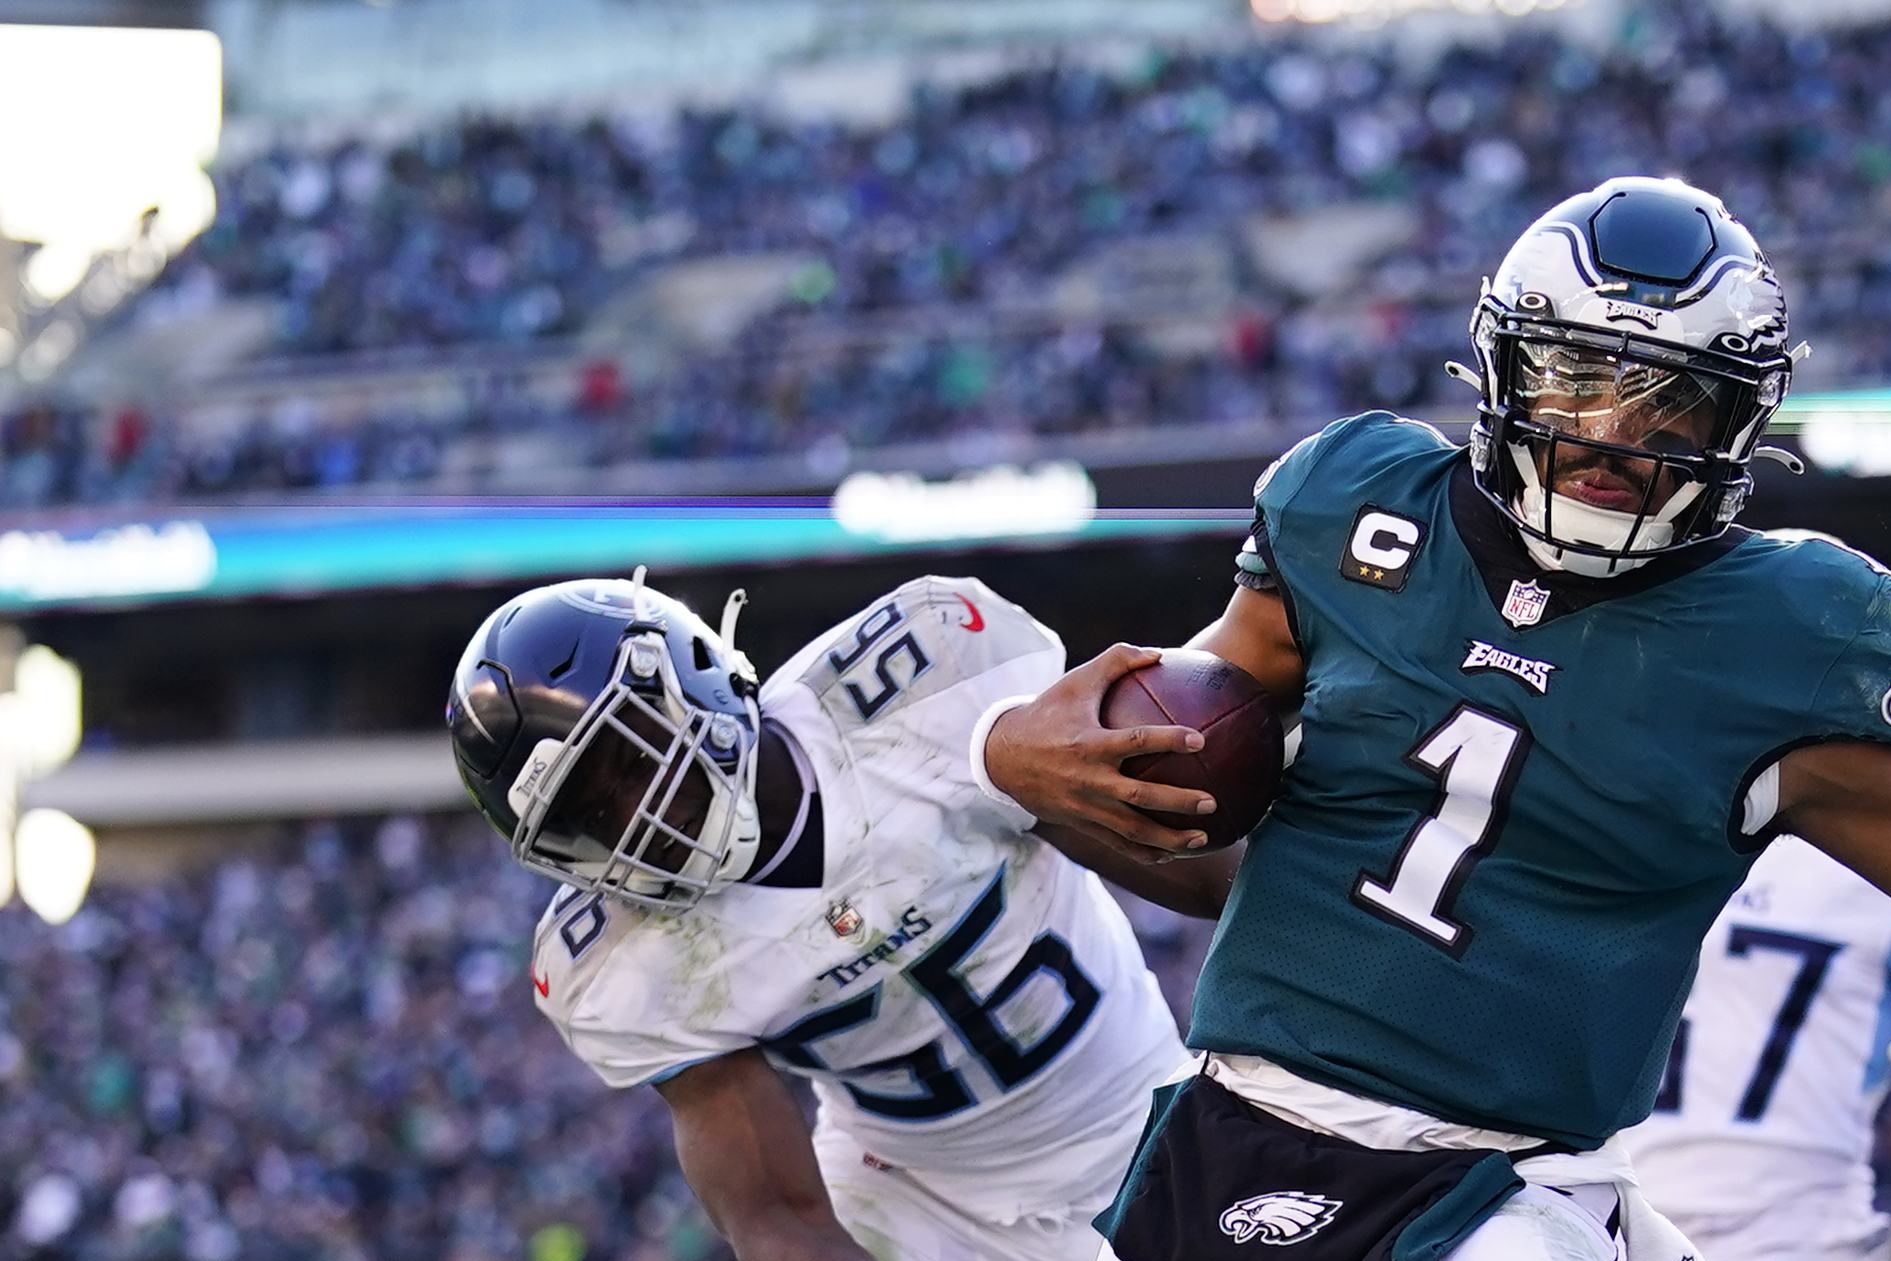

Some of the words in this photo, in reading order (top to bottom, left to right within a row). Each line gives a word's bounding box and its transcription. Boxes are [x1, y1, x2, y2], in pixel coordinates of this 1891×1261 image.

[1605, 301, 1661, 330] EAGLES
[1351, 513, 1419, 570] C
[1509, 599, 1537, 619] NFL
[1461, 640, 1560, 694] EAGLES
[1353, 703, 1528, 954] 1
[816, 906, 933, 989] TITANS
[758, 860, 1105, 1124] 56
